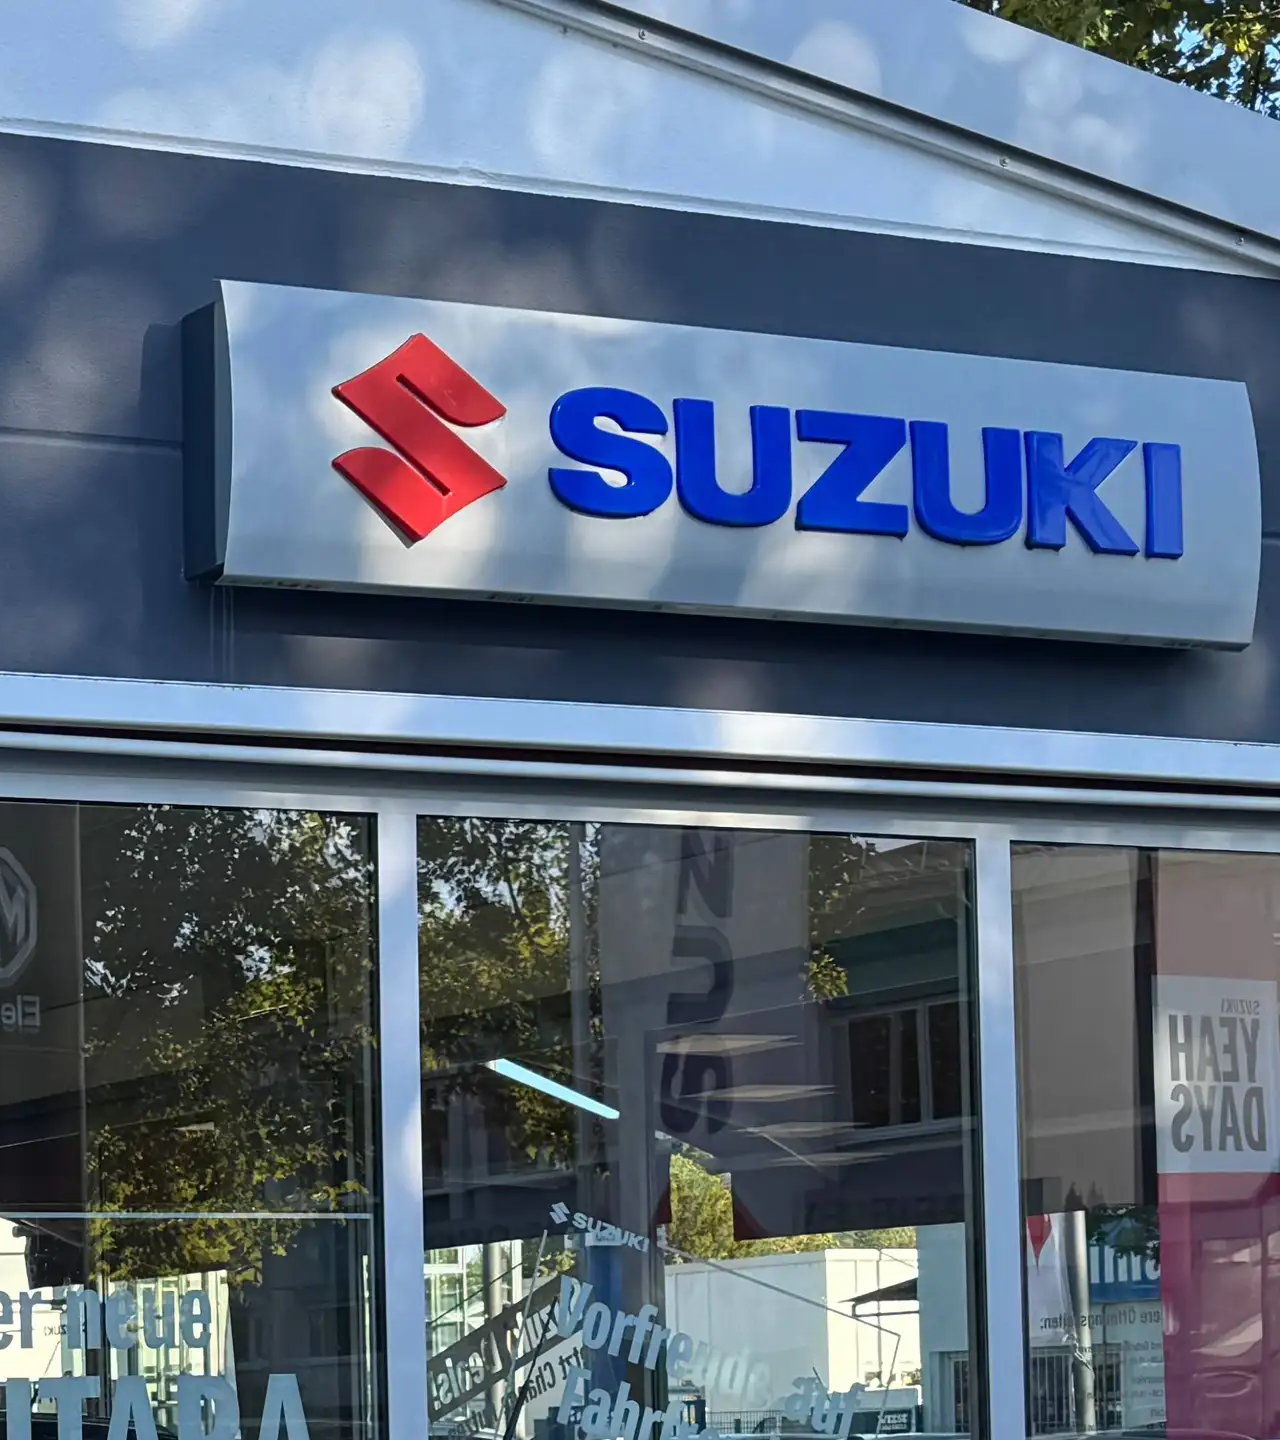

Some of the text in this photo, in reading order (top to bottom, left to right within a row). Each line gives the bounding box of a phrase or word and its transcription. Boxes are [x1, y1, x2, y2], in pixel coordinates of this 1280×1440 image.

[548, 386, 1184, 560] SUZUKI
[571, 1211, 650, 1253] SUZUKI
[66, 1286, 213, 1351] neue
[557, 1275, 868, 1436] Vorfreude auf
